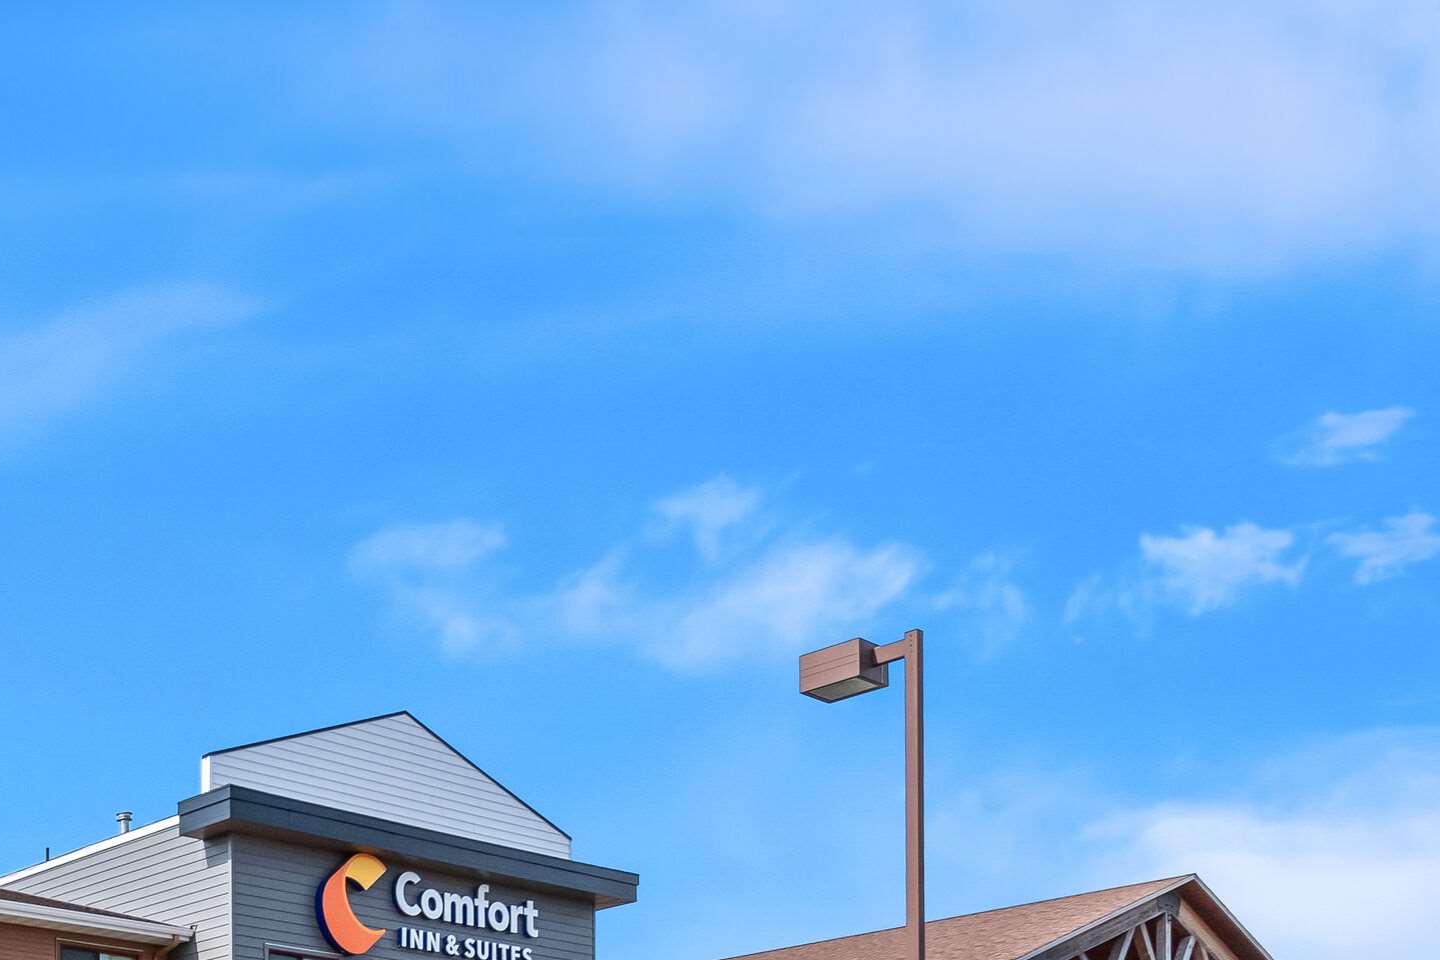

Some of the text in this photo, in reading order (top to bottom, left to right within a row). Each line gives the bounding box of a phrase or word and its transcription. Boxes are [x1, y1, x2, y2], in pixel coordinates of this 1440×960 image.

[394, 871, 539, 938] Comfort
[399, 927, 441, 953] INN
[445, 934, 460, 956] &
